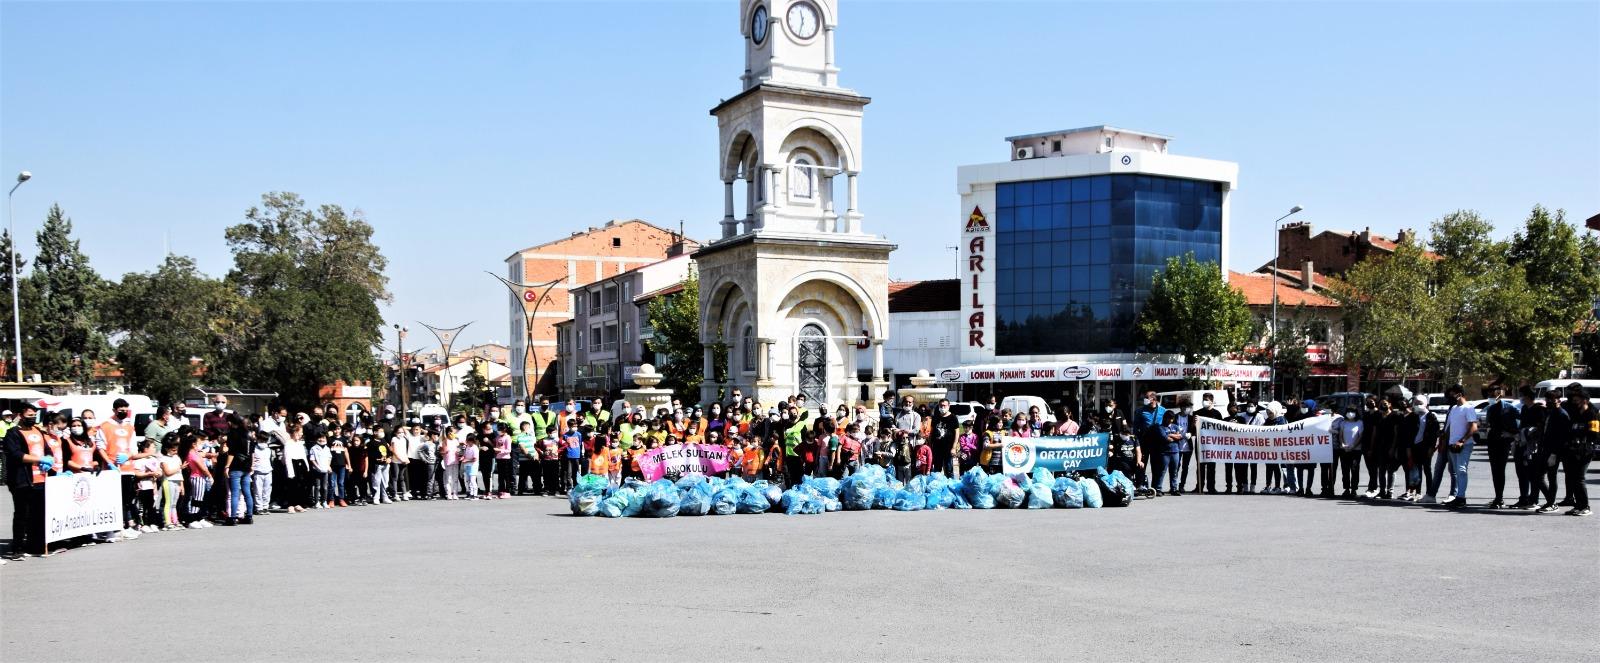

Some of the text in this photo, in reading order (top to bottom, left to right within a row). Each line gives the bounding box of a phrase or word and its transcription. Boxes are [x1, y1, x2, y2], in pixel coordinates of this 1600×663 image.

[969, 236, 985, 348] ARILAR
[970, 370, 996, 380] LOKUM
[1000, 368, 1026, 381] PİŞMANİYE
[1030, 368, 1055, 379] SUCUK
[1287, 422, 1305, 434] ÇAY
[1200, 434, 1330, 447] GEVHER NESİBE MESLEKİ VE
[652, 448, 723, 464] MELEK SULTAN
[1040, 447, 1104, 460] ORTAOKULU
[1201, 448, 1311, 461] TEKNİK ANADOLU LİSESİ
[666, 464, 708, 475] ANOKULU
[1063, 459, 1082, 470] ÇAY
[64, 511, 91, 530] Anadolu
[92, 506, 117, 526] Lisesi
